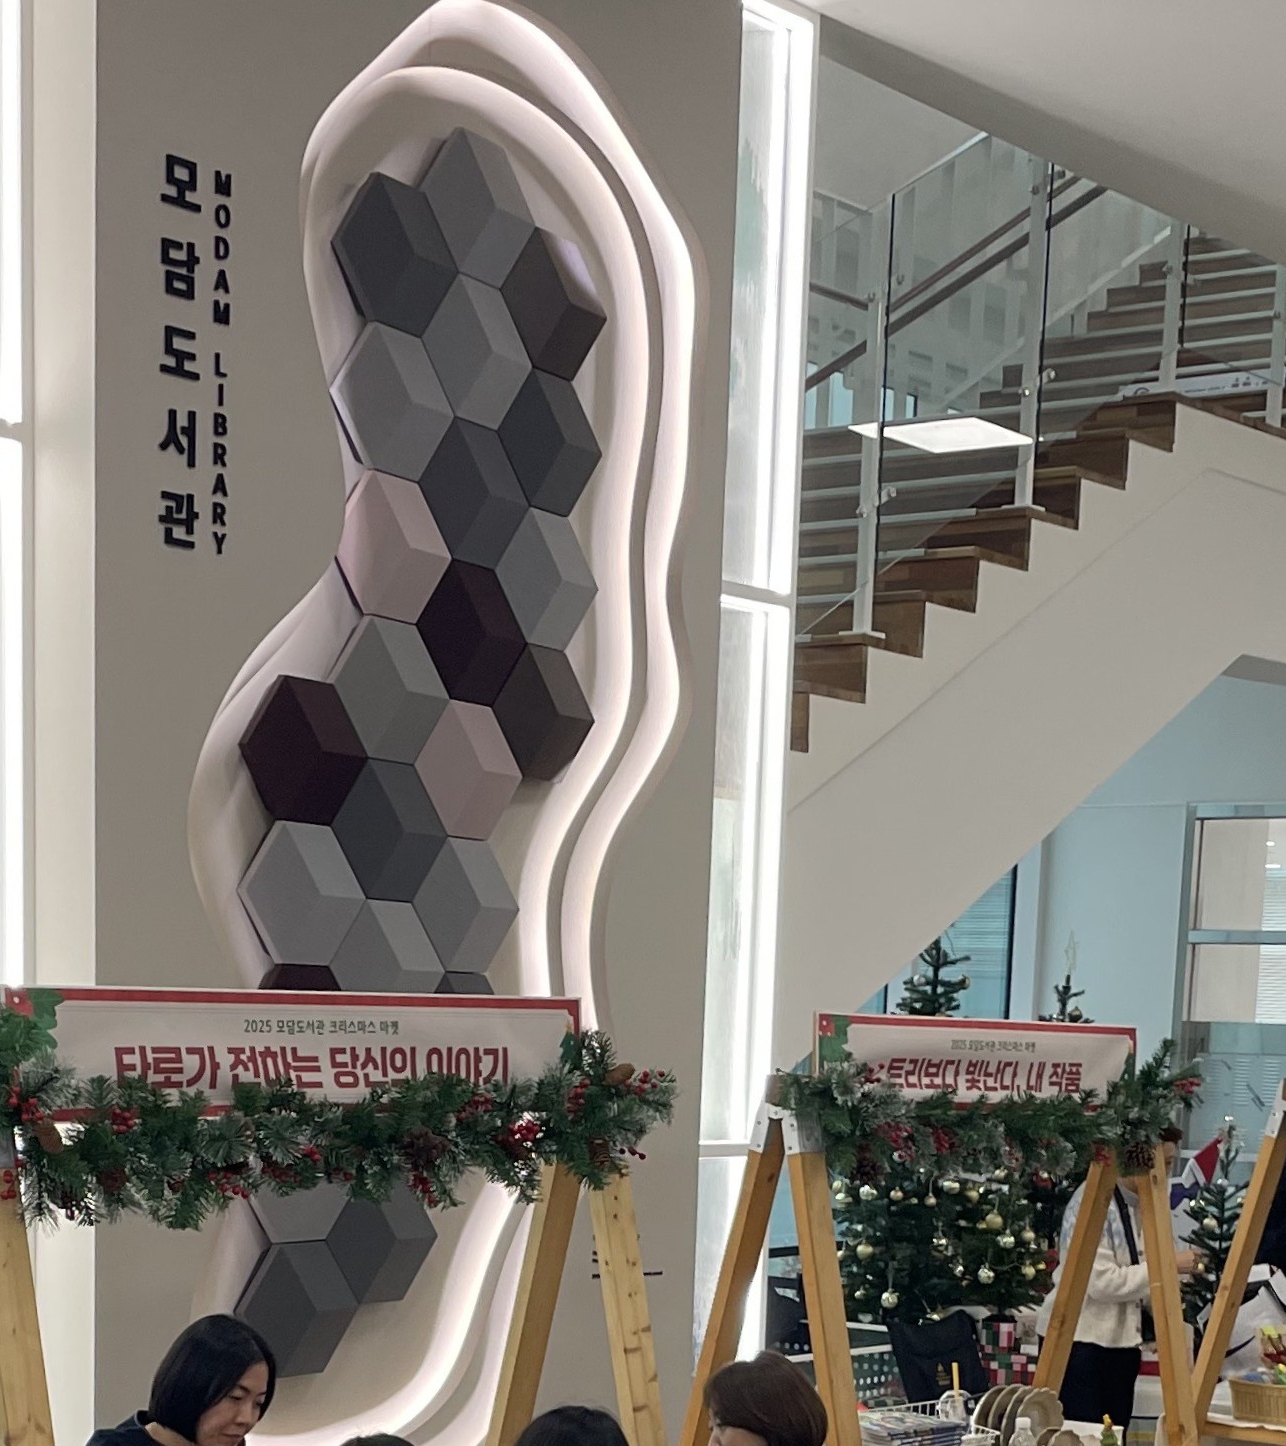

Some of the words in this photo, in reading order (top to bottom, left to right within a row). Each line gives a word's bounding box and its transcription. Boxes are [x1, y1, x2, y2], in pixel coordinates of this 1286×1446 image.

[213, 169, 232, 326] MODAM
[158, 153, 202, 550] 모담도서관
[211, 352, 229, 555] LIBRARY
[114, 1045, 221, 1090] 타로가
[226, 1045, 324, 1089] 전하는
[328, 1046, 418, 1089] 당신의
[426, 1046, 509, 1088] 이야기
[243, 1018, 273, 1034] 2025
[276, 1019, 325, 1036] 모담도서관
[328, 1019, 377, 1035] 크리스마스
[379, 1020, 400, 1036] 마켓
[1026, 1061, 1047, 1093] 내
[1048, 1062, 1083, 1094] 작품
